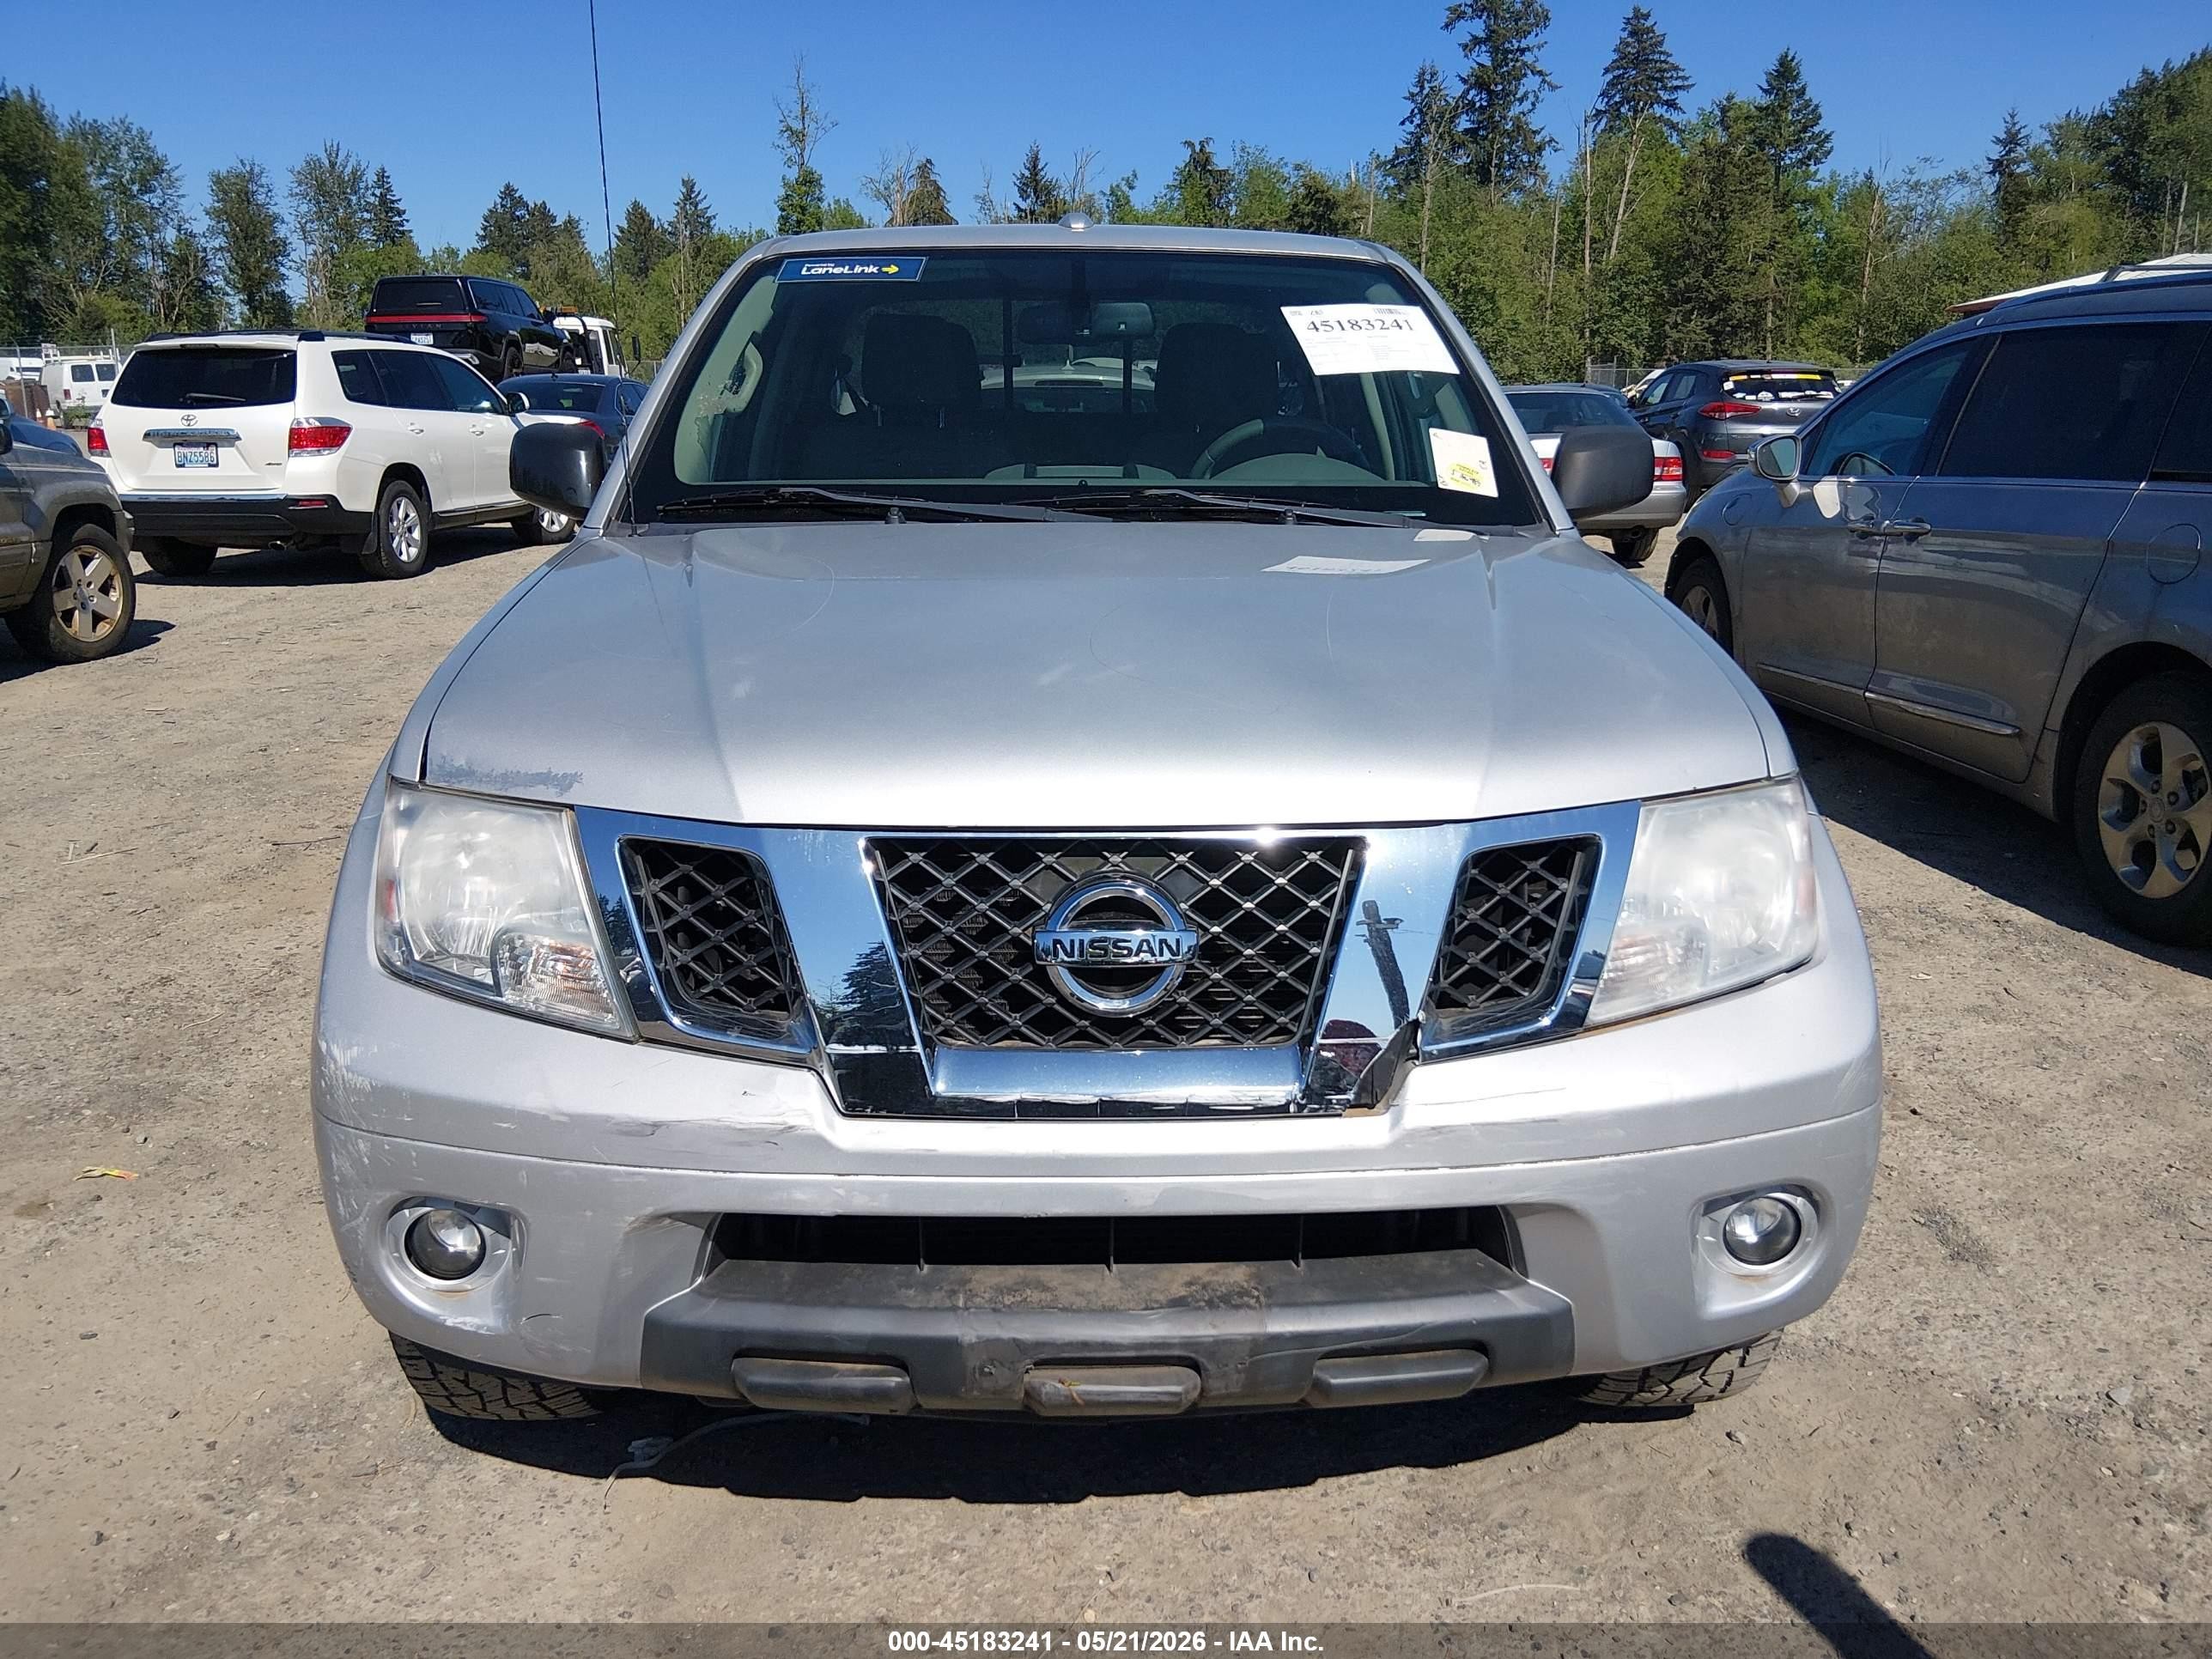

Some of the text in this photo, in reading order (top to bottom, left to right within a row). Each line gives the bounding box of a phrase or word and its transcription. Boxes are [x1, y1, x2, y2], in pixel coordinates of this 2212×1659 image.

[801, 264, 879, 275] LaneLink
[1306, 319, 1414, 332] 45183241
[177, 451, 215, 463] BNZ5586
[1052, 936, 1182, 959] NISSAN
